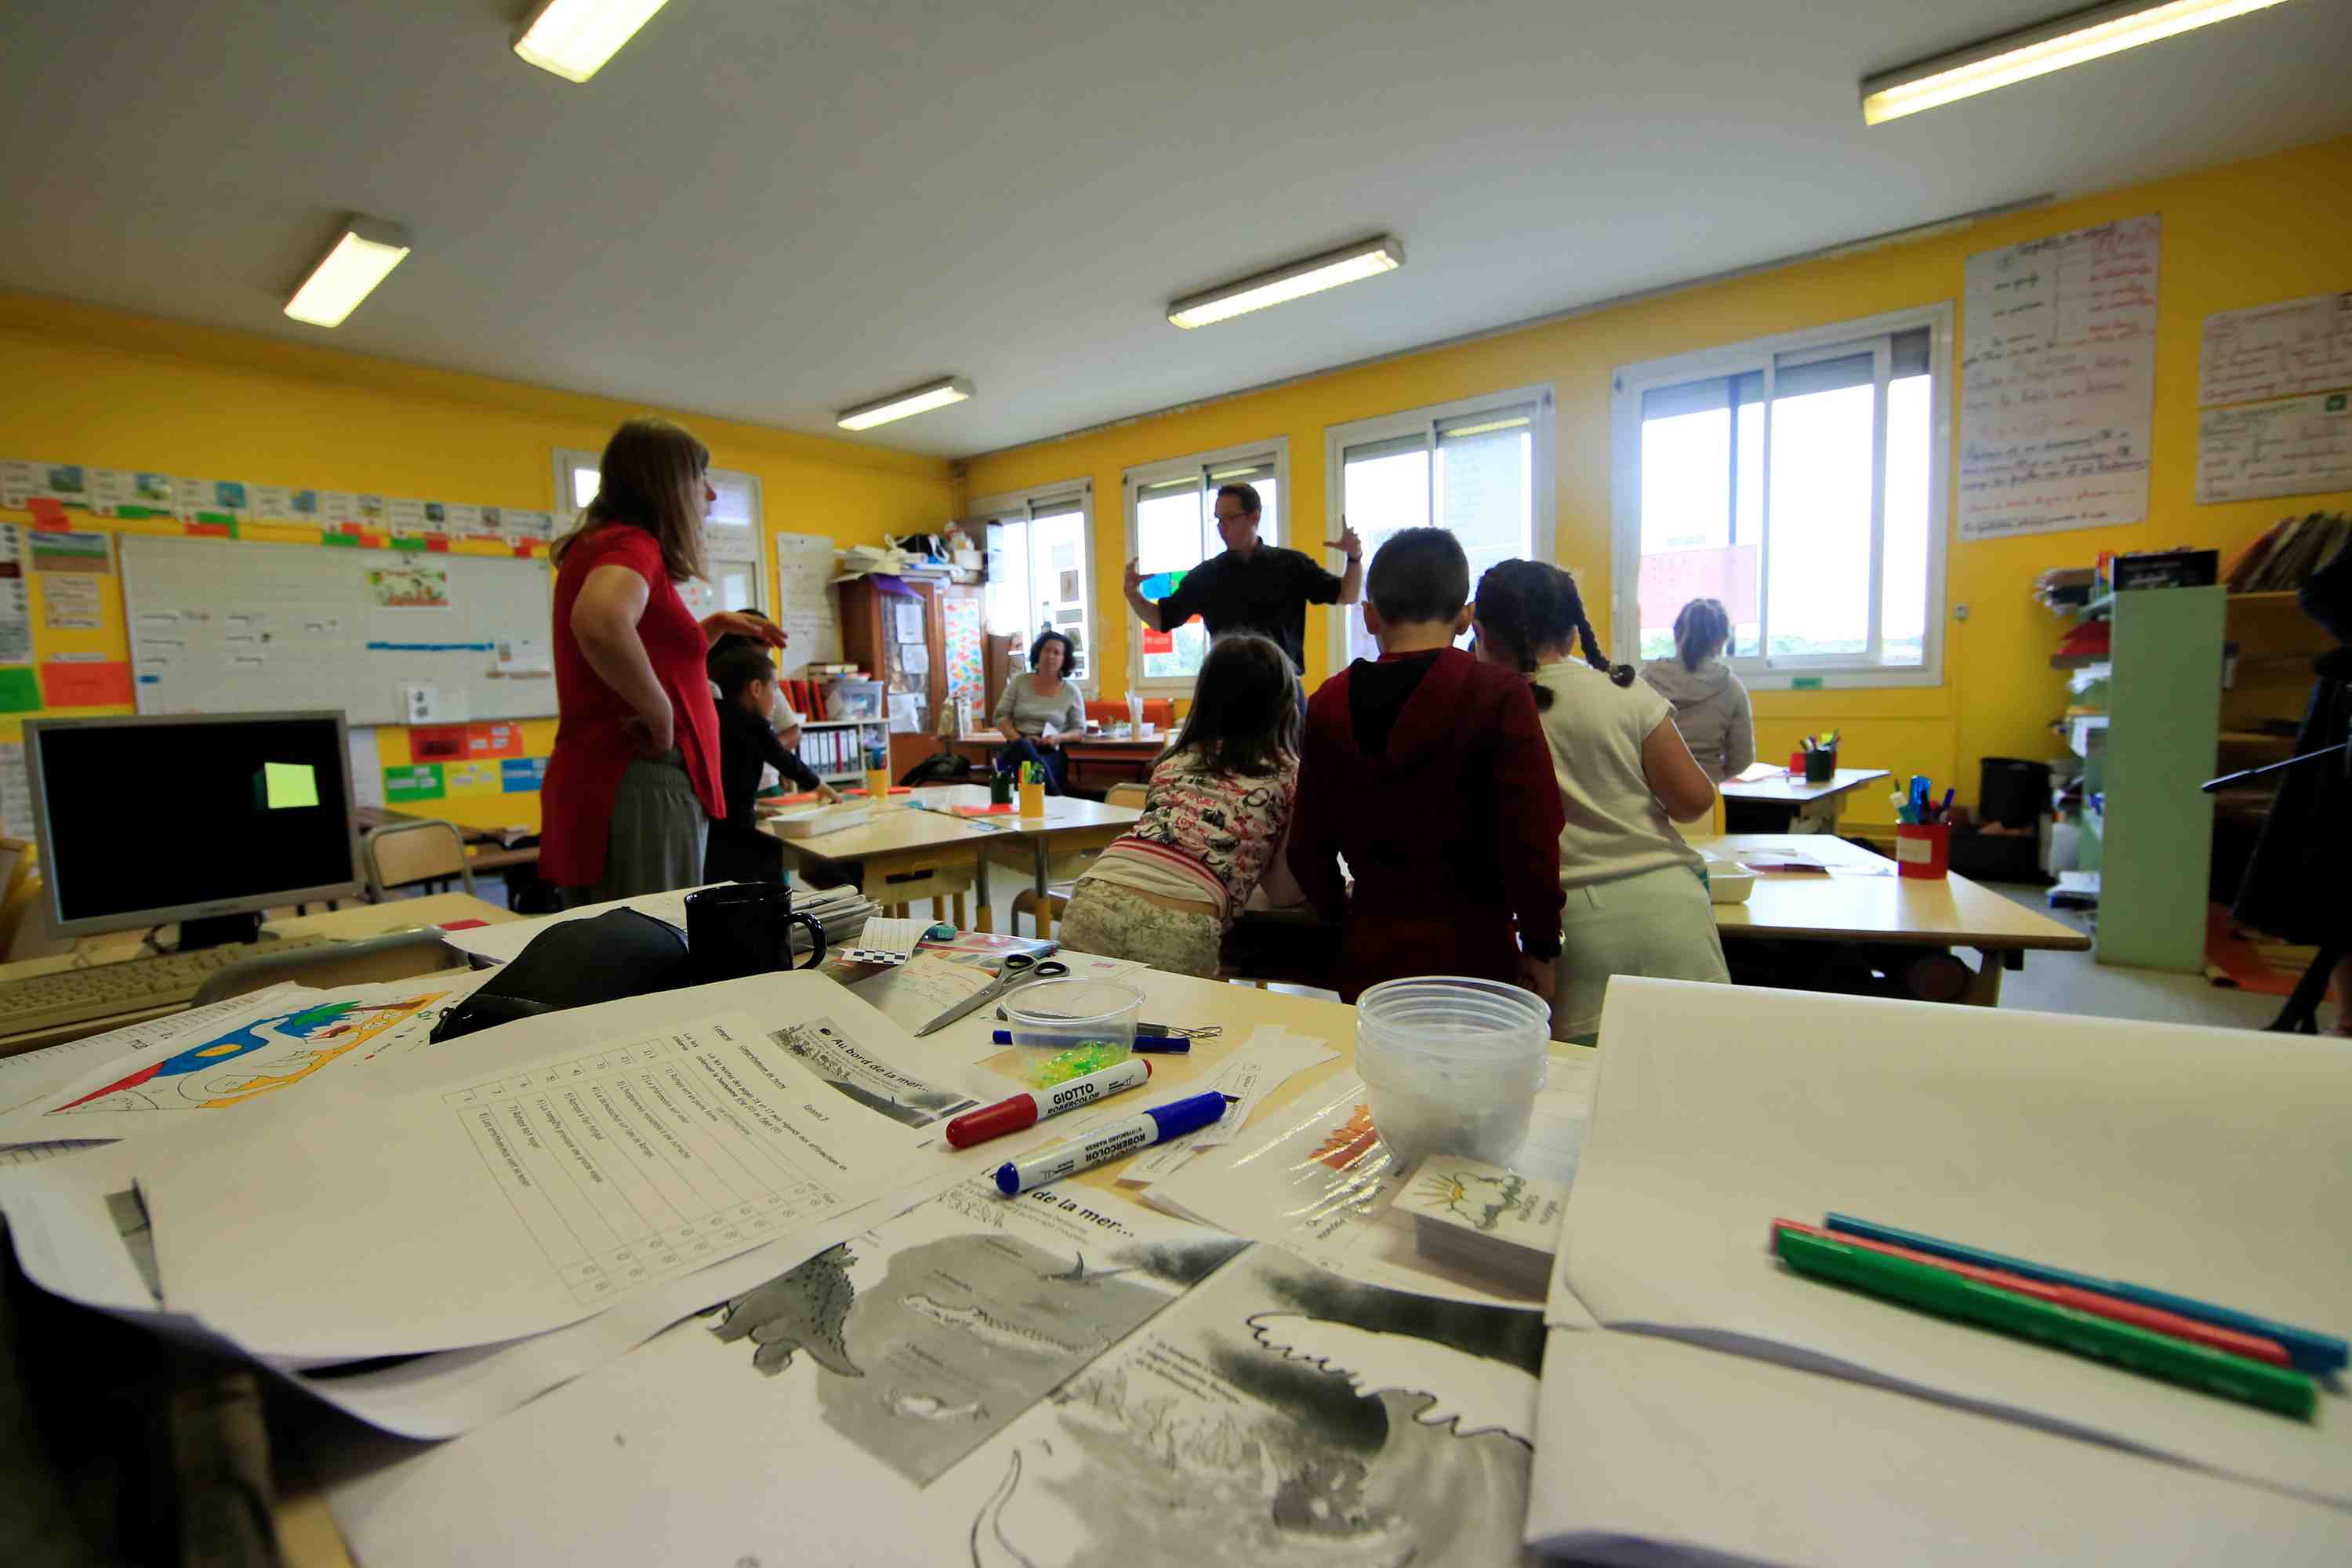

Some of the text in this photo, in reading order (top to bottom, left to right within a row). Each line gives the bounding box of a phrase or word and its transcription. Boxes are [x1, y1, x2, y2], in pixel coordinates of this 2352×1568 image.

[832, 1037, 930, 1093] Au bord de la mer...
[1047, 1092, 1100, 1116] ROBERCOLOR
[1054, 1083, 1094, 1105] GIOTTO
[1085, 1133, 1145, 1161] ROBERCOLOR
[1032, 1188, 1135, 1238] de la mer...
